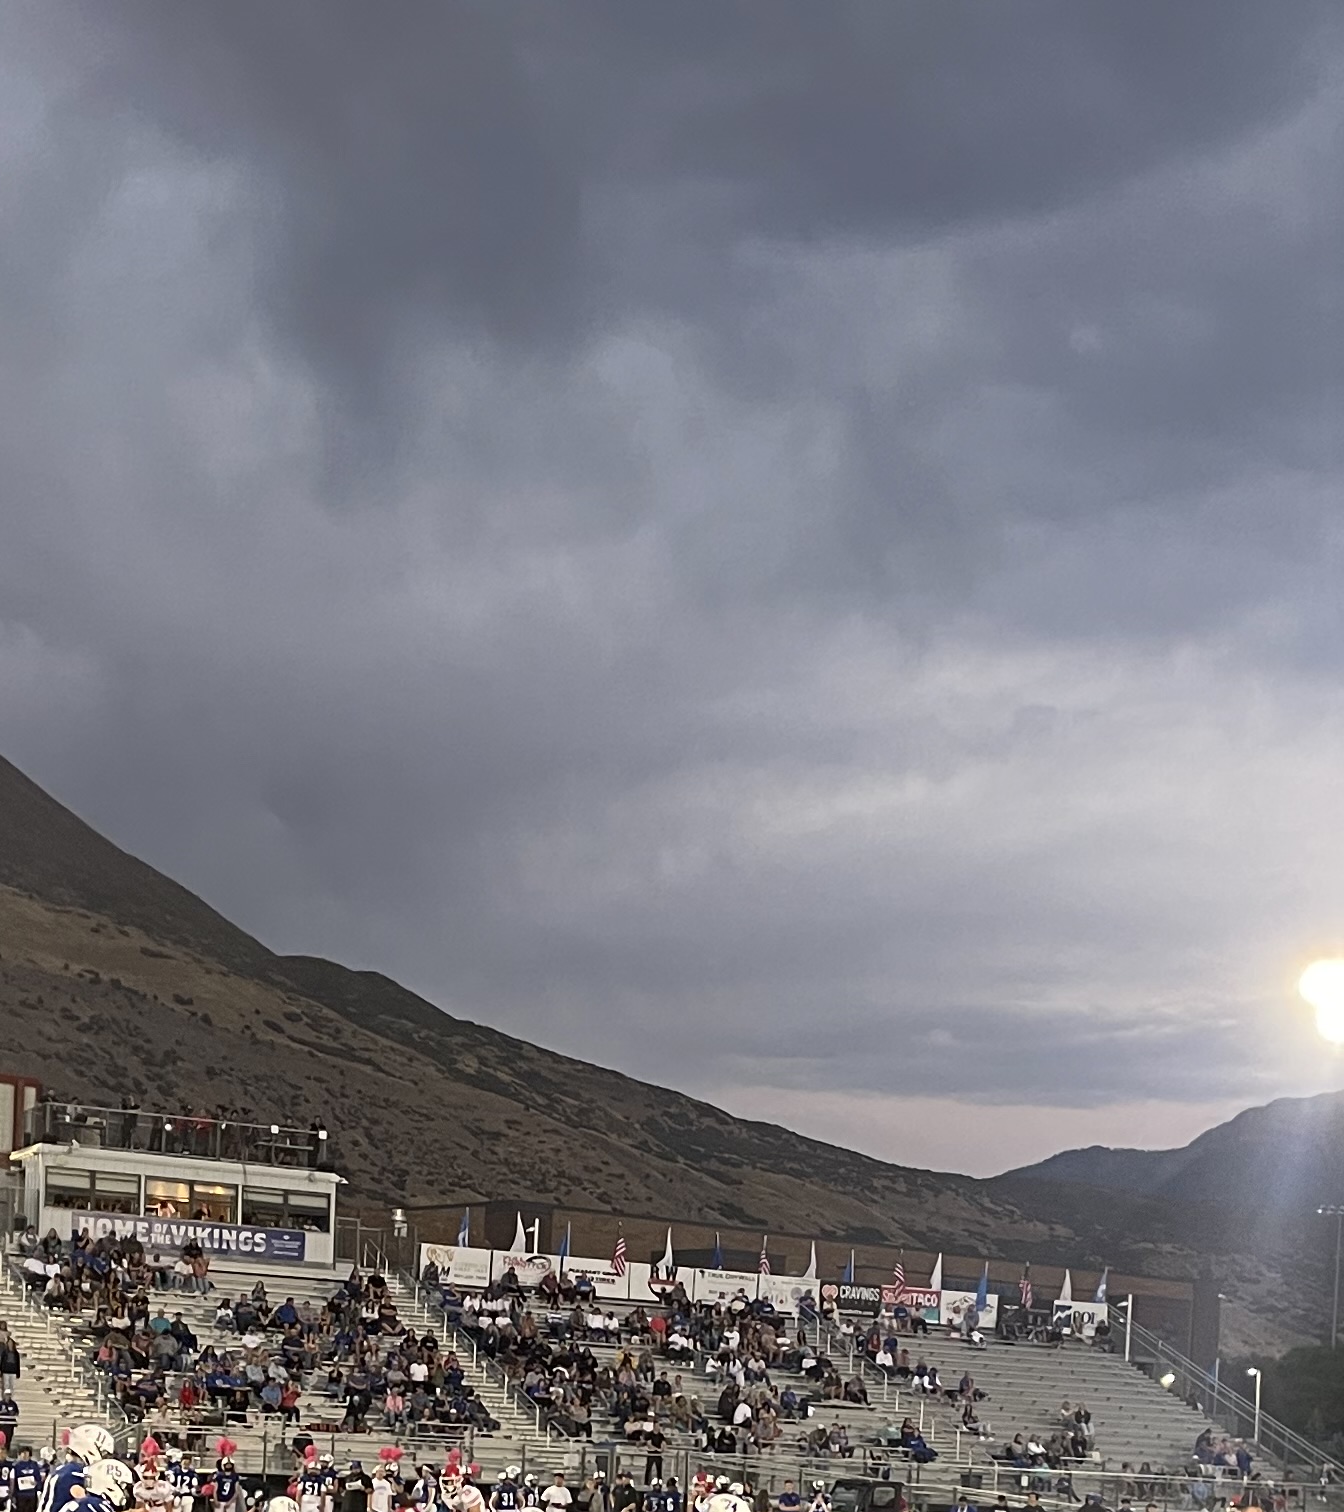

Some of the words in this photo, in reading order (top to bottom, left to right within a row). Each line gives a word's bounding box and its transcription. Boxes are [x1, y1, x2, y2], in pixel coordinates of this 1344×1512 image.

[78, 1216, 149, 1243] HOME
[149, 1234, 171, 1245] THE
[171, 1225, 267, 1253] VIKINGS
[840, 1285, 880, 1302] CRAVINGS
[305, 1482, 319, 1496] 51
[501, 1493, 514, 1506] 31
